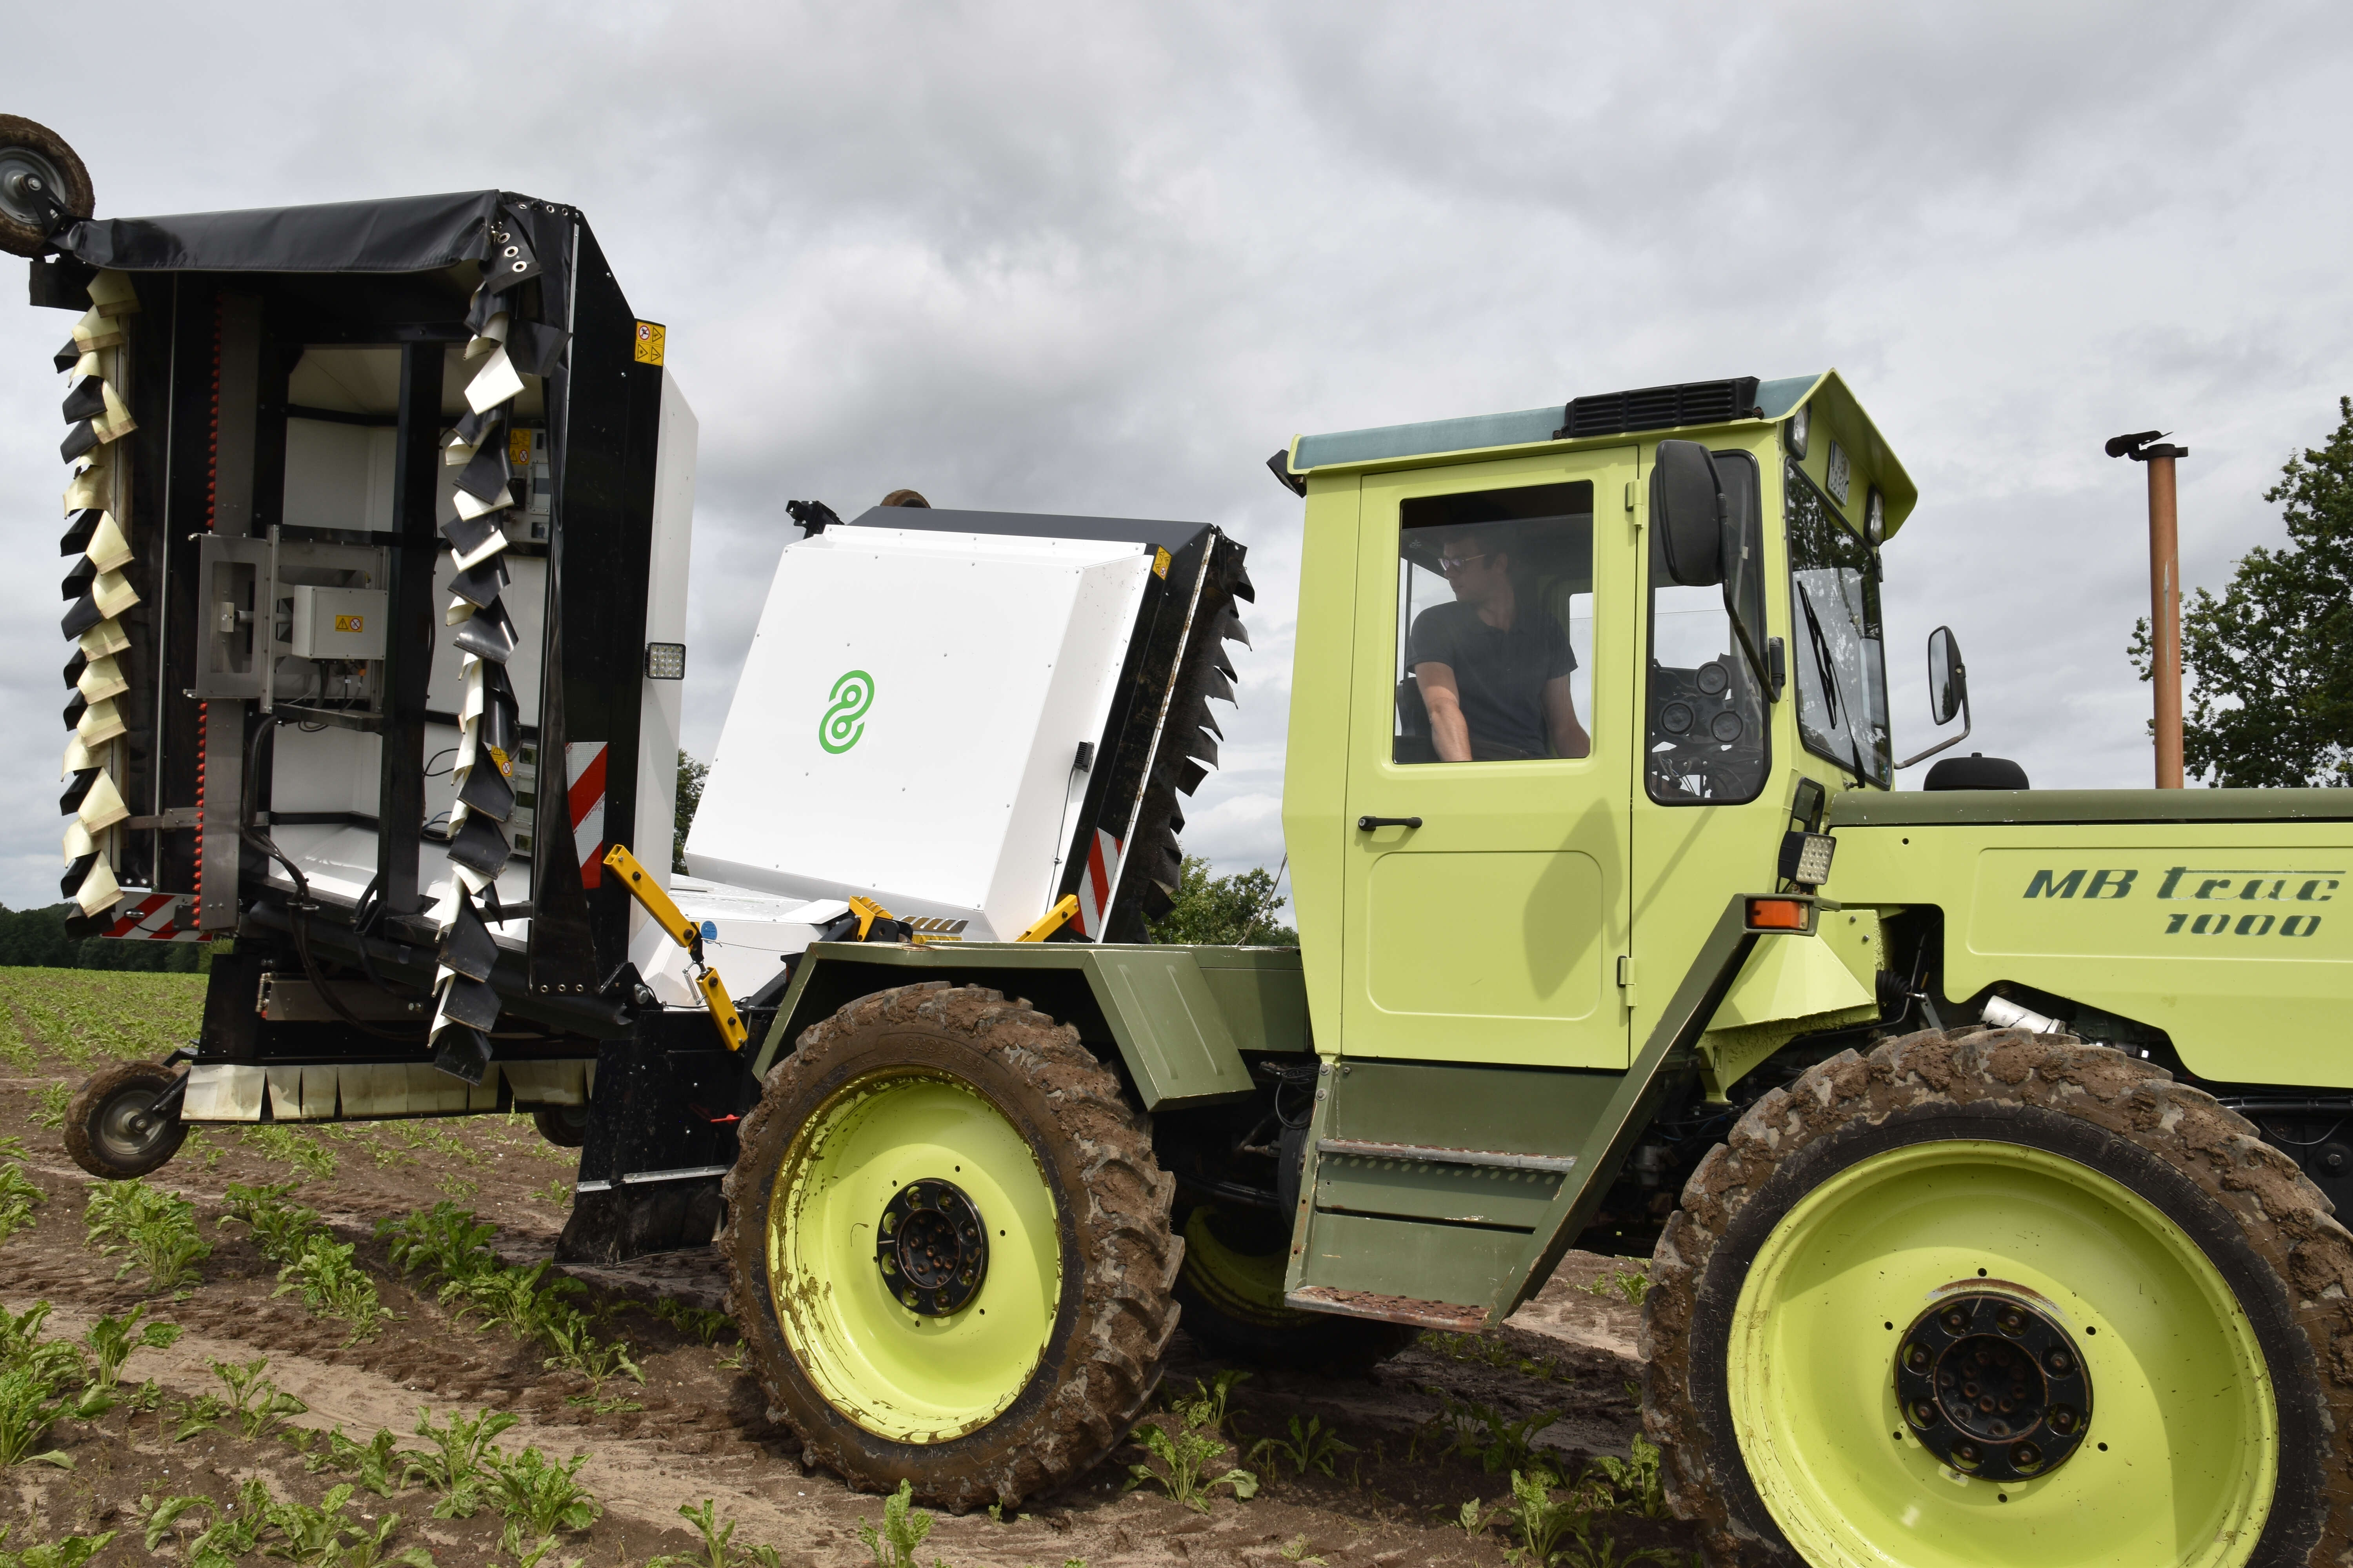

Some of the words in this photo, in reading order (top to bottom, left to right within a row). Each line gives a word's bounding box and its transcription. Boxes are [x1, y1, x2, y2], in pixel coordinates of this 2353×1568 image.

[2022, 869, 2138, 899] MB
[2157, 866, 2346, 901] trac
[2164, 913, 2322, 937] 1000
[904, 1037, 986, 1072] CROPKER
[2067, 1123, 2211, 1217] CROPKER
